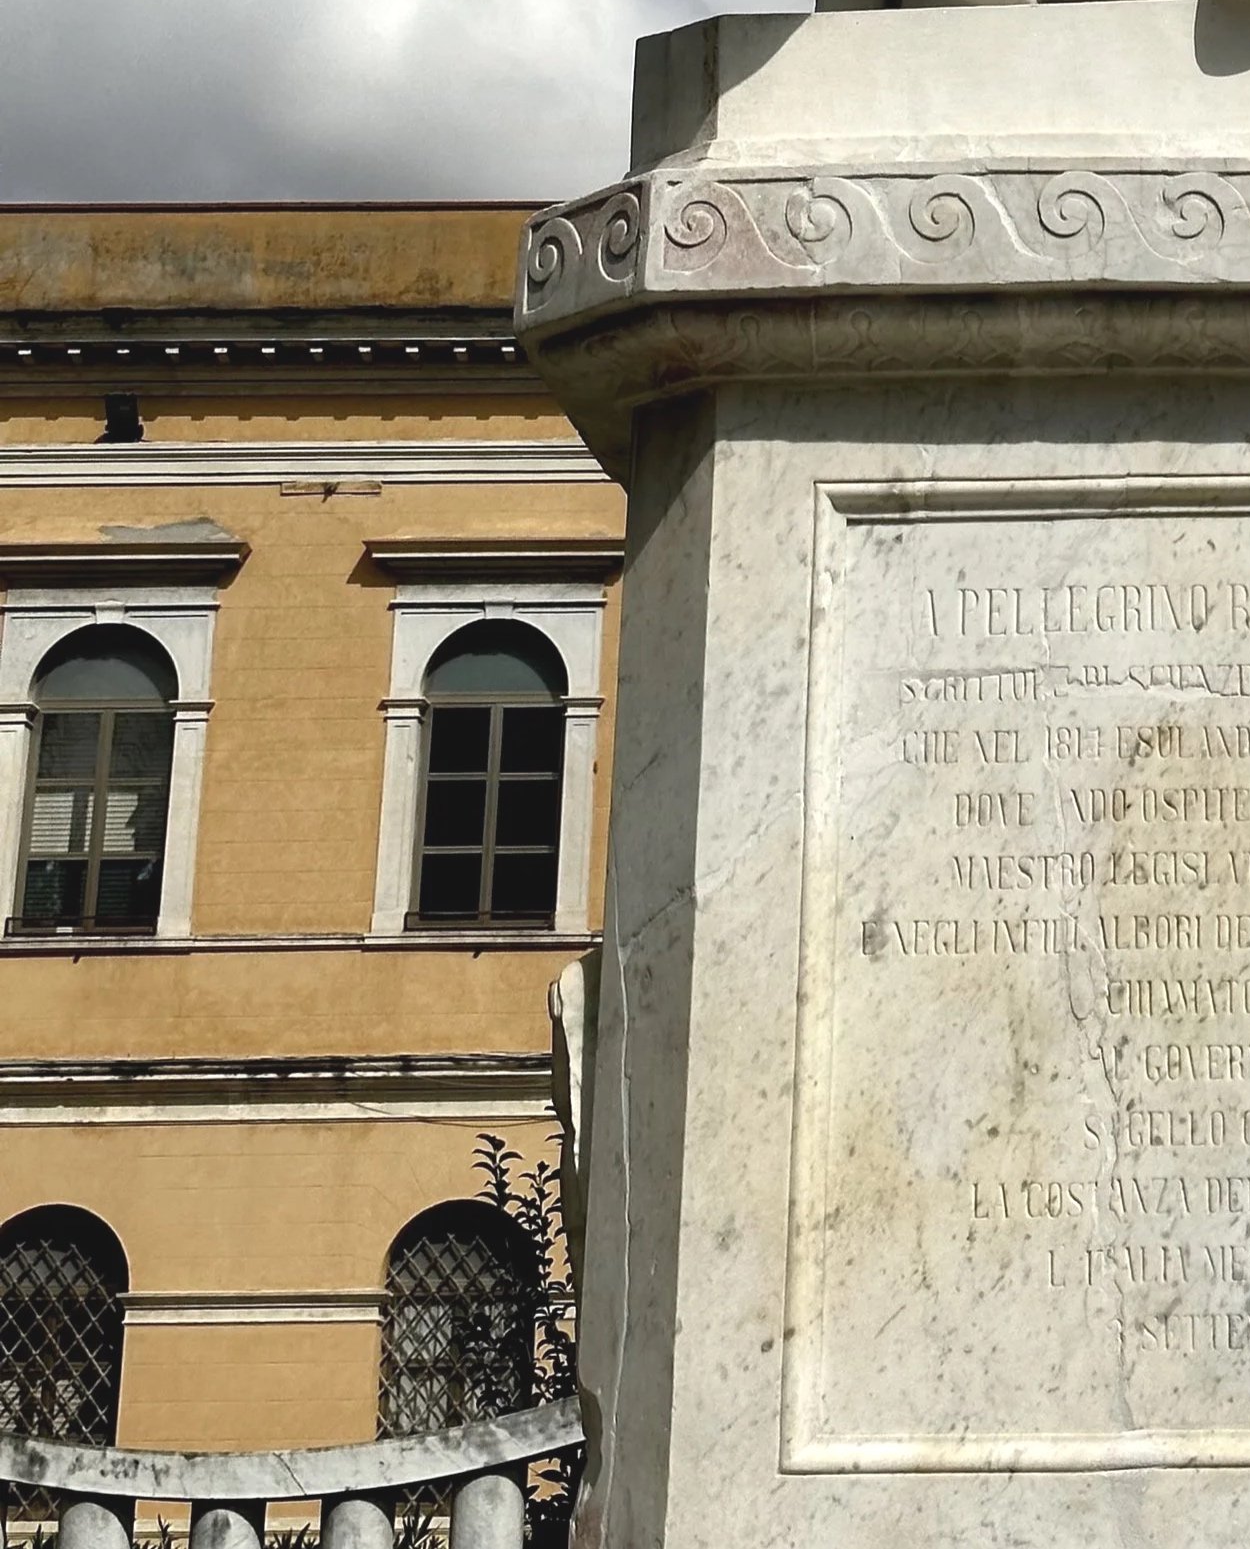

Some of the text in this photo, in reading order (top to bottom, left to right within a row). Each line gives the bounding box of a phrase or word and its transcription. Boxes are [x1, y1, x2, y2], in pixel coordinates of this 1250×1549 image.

[920, 588, 939, 637] A
[957, 584, 1209, 637] PELLEGRINO
[903, 728, 958, 764] CHE
[973, 728, 1030, 764] NEL
[955, 792, 1035, 827] DOVE
[1141, 787, 1250, 823] OSPITE
[952, 851, 1095, 890] MAESTRO
[861, 919, 877, 955] E
[894, 918, 979, 955] NEGLI
[1096, 915, 1200, 950] ALBORI
[972, 1182, 1009, 1219] LA
[1025, 1177, 1191, 1219] COSTANZA
